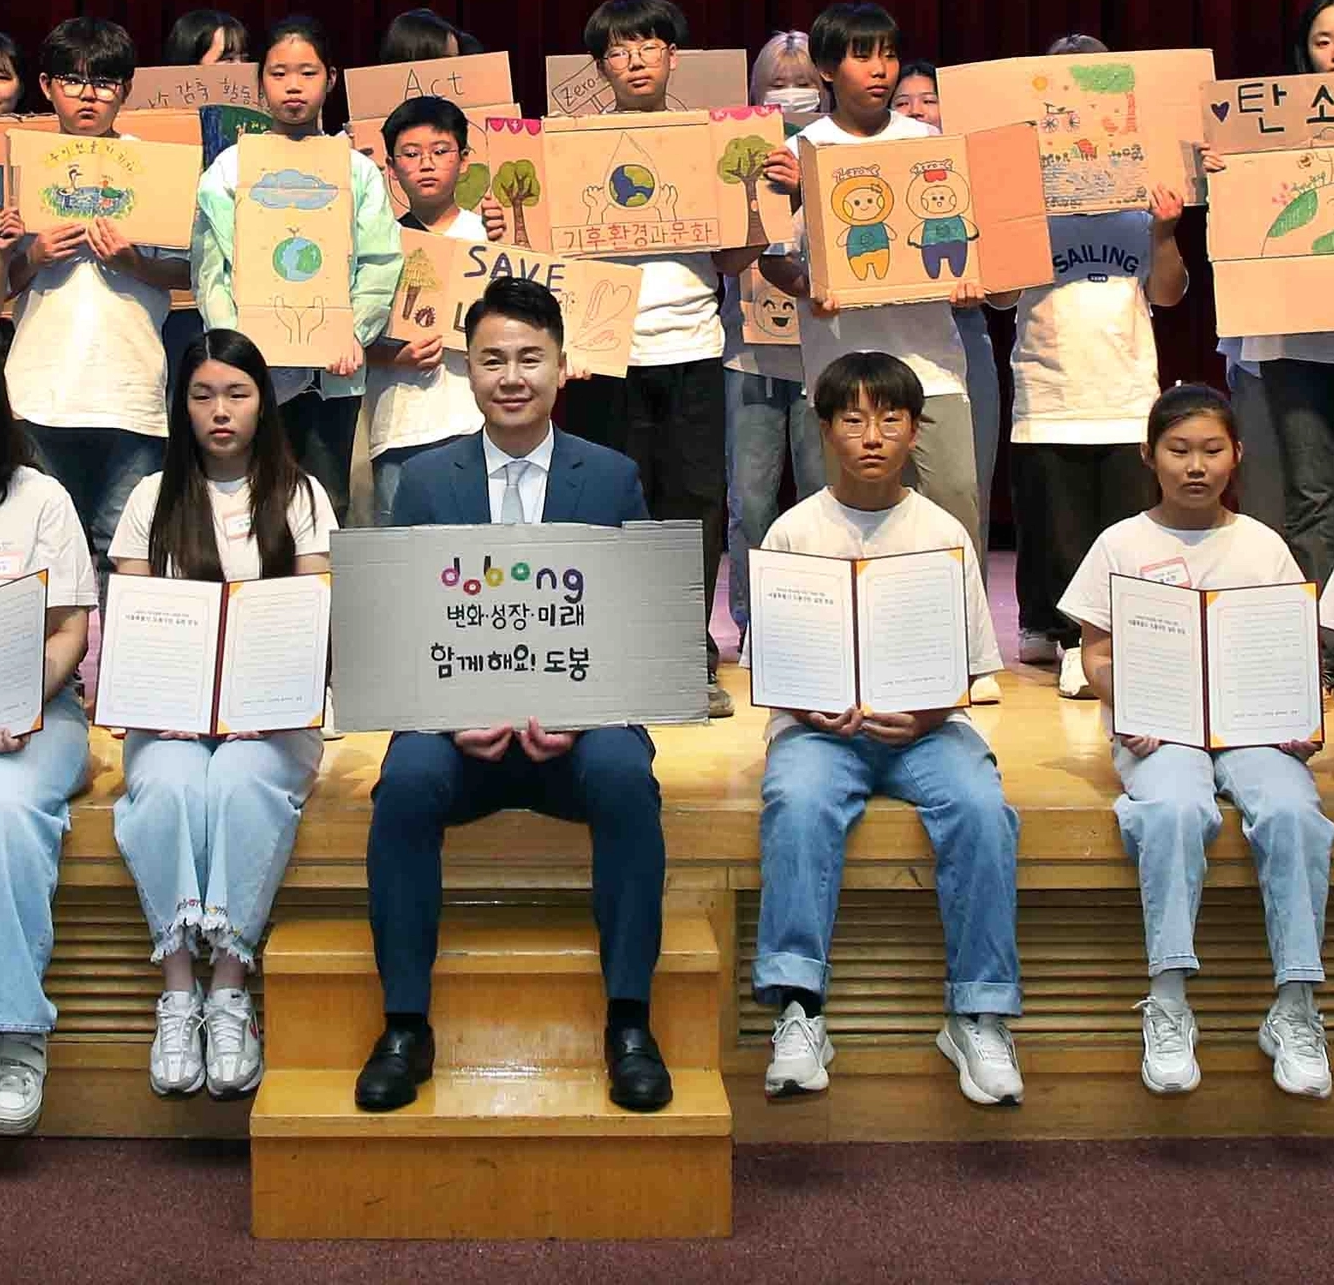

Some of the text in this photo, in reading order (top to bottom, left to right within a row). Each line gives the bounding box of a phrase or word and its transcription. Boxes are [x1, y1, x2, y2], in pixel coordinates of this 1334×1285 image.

[403, 67, 464, 100] Act
[464, 245, 566, 292] SAVE
[1052, 244, 1139, 275] SAILING
[441, 555, 584, 604] dobong
[430, 642, 590, 682] 함께해요! 도봉
